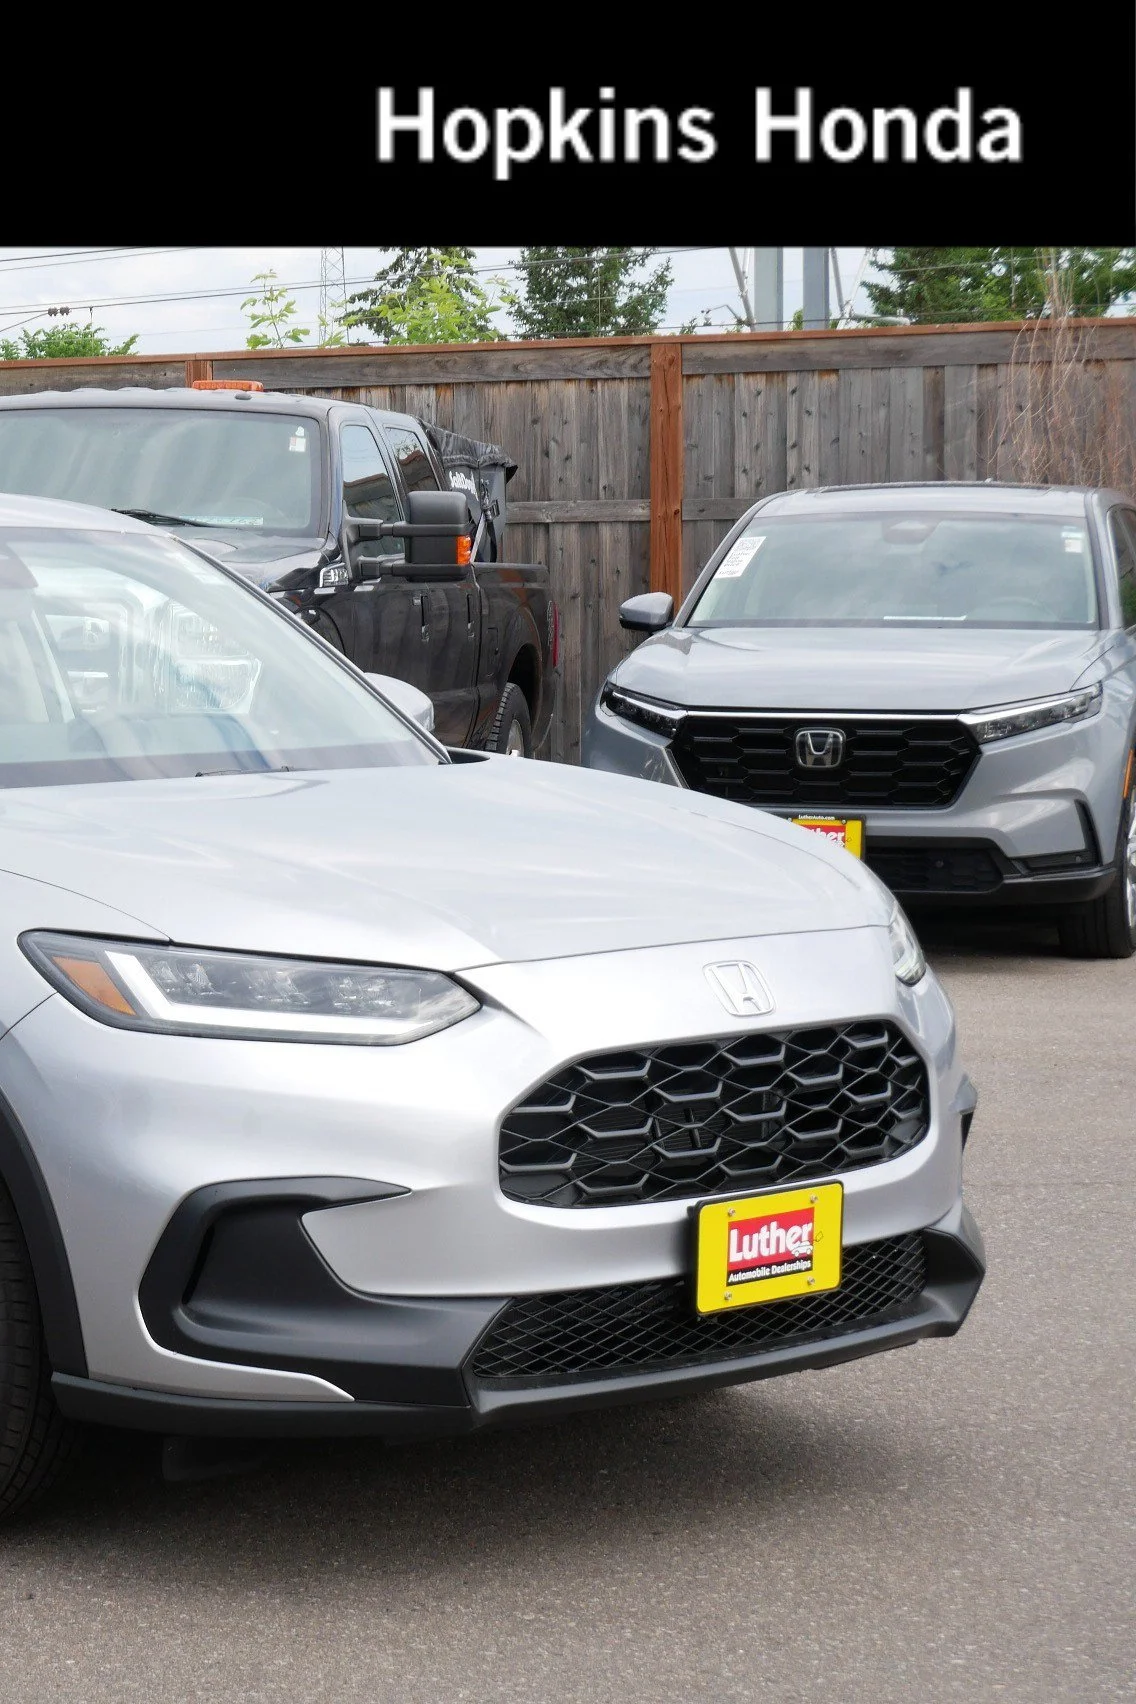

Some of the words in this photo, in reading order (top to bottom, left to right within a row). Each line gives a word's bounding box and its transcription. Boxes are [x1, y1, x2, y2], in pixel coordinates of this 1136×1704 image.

[729, 1221, 813, 1262] Luther
[728, 1268, 770, 1283] Automobile
[771, 1259, 811, 1275] Dealerships
